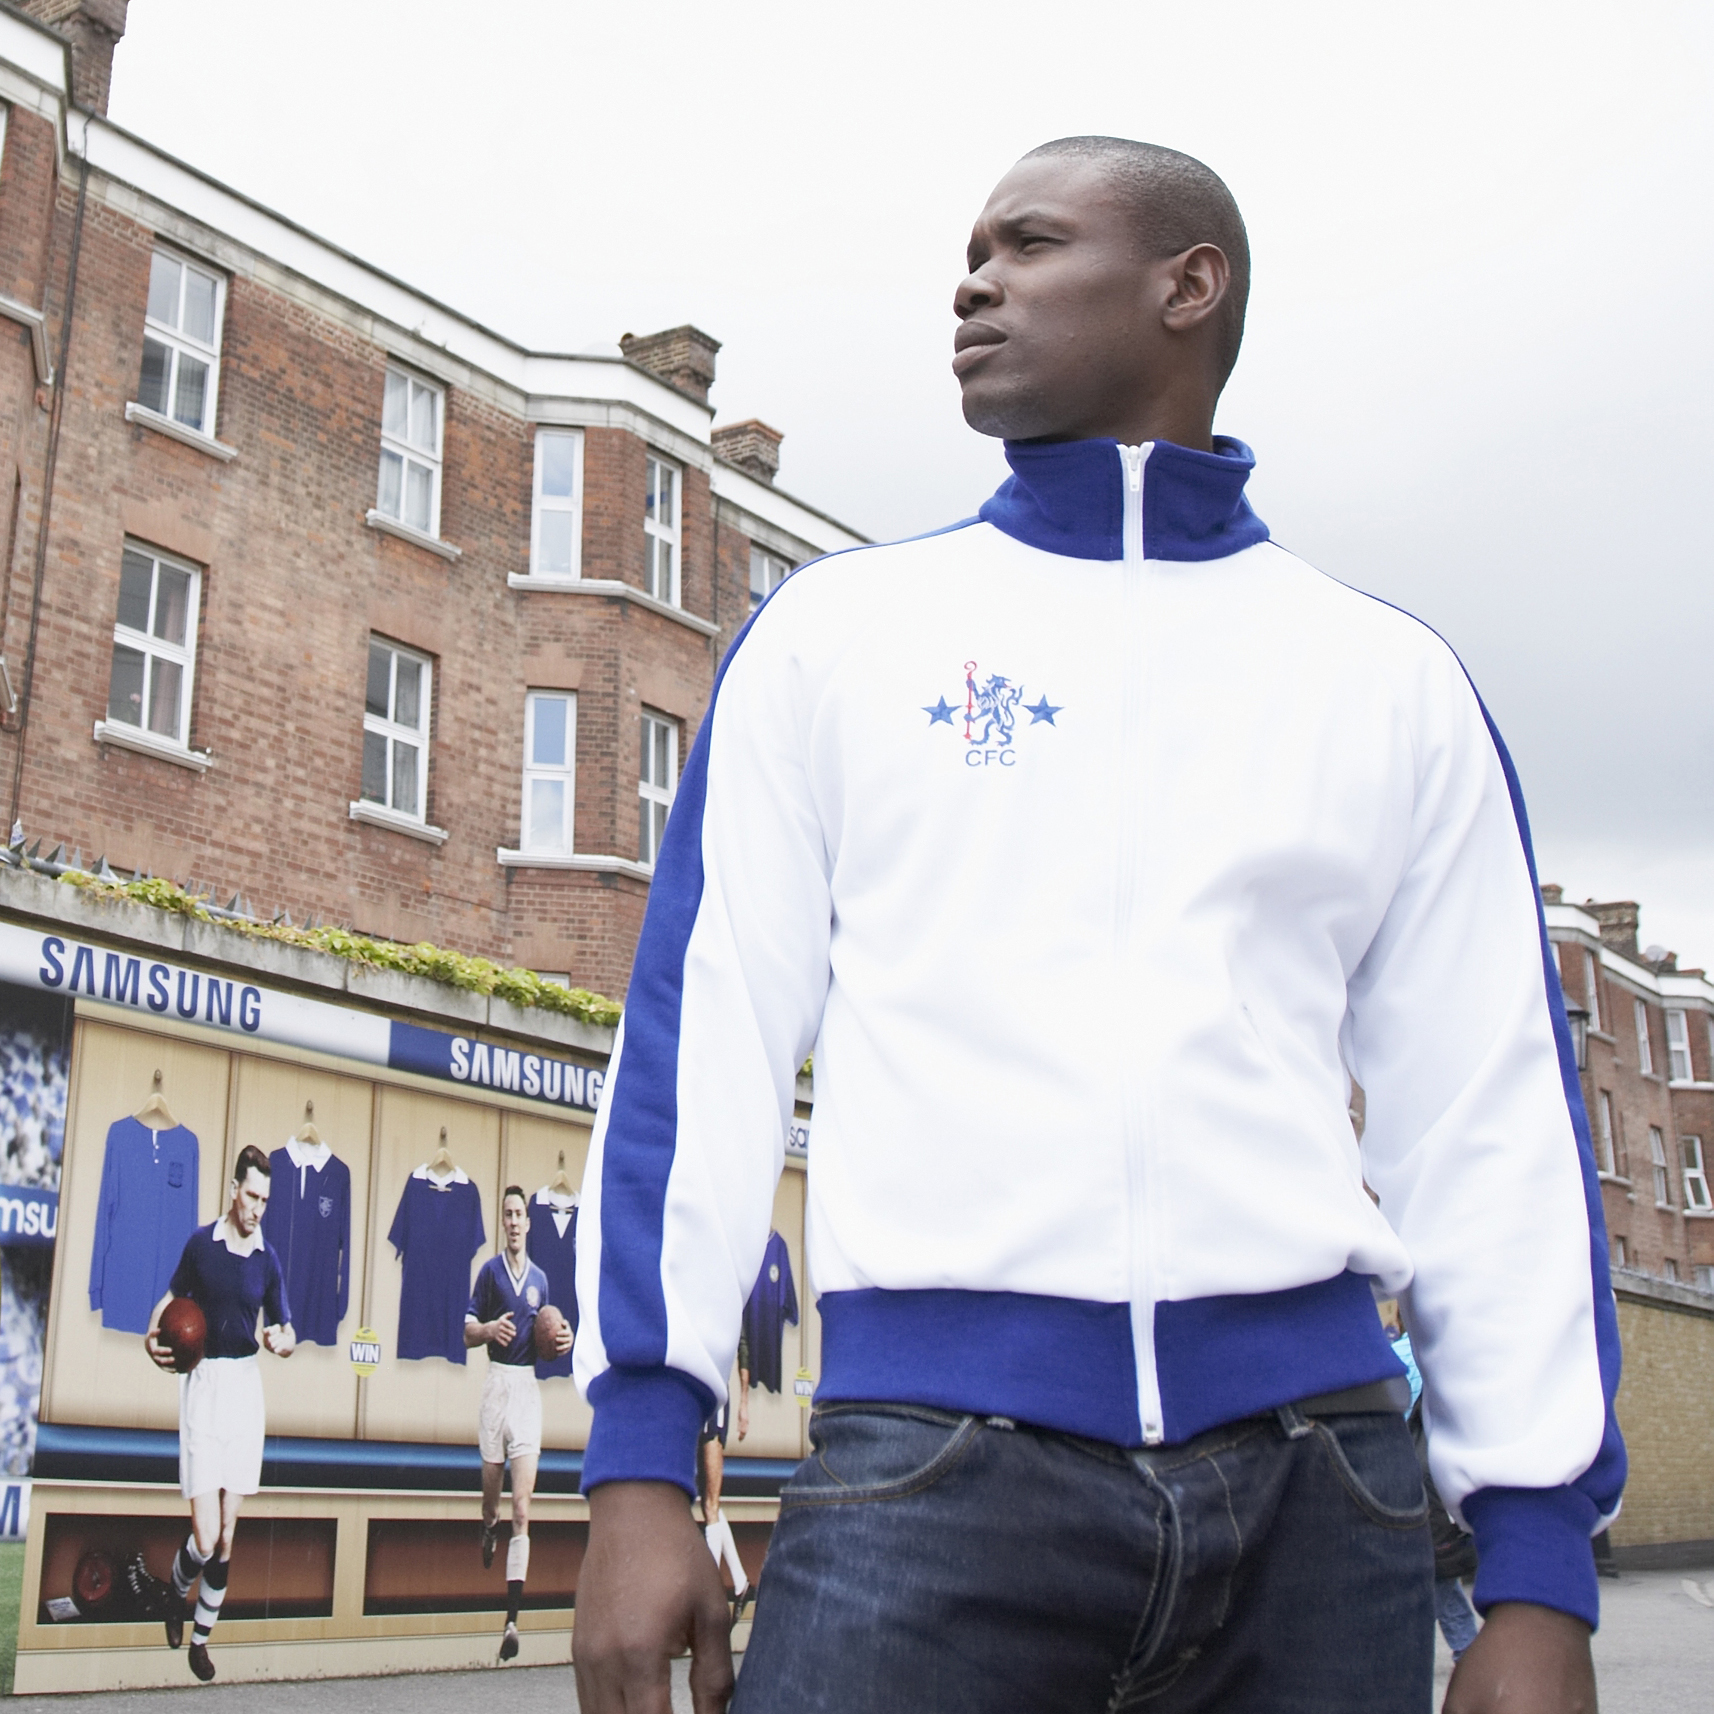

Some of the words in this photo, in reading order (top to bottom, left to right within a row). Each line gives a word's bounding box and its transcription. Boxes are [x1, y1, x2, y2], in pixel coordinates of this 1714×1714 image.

[965, 749, 1016, 767] CFC
[39, 936, 262, 1033] SAMSUNG
[450, 1037, 604, 1110] SAMSUNG
[789, 1125, 810, 1149] sa
[351, 1342, 380, 1363] WIN
